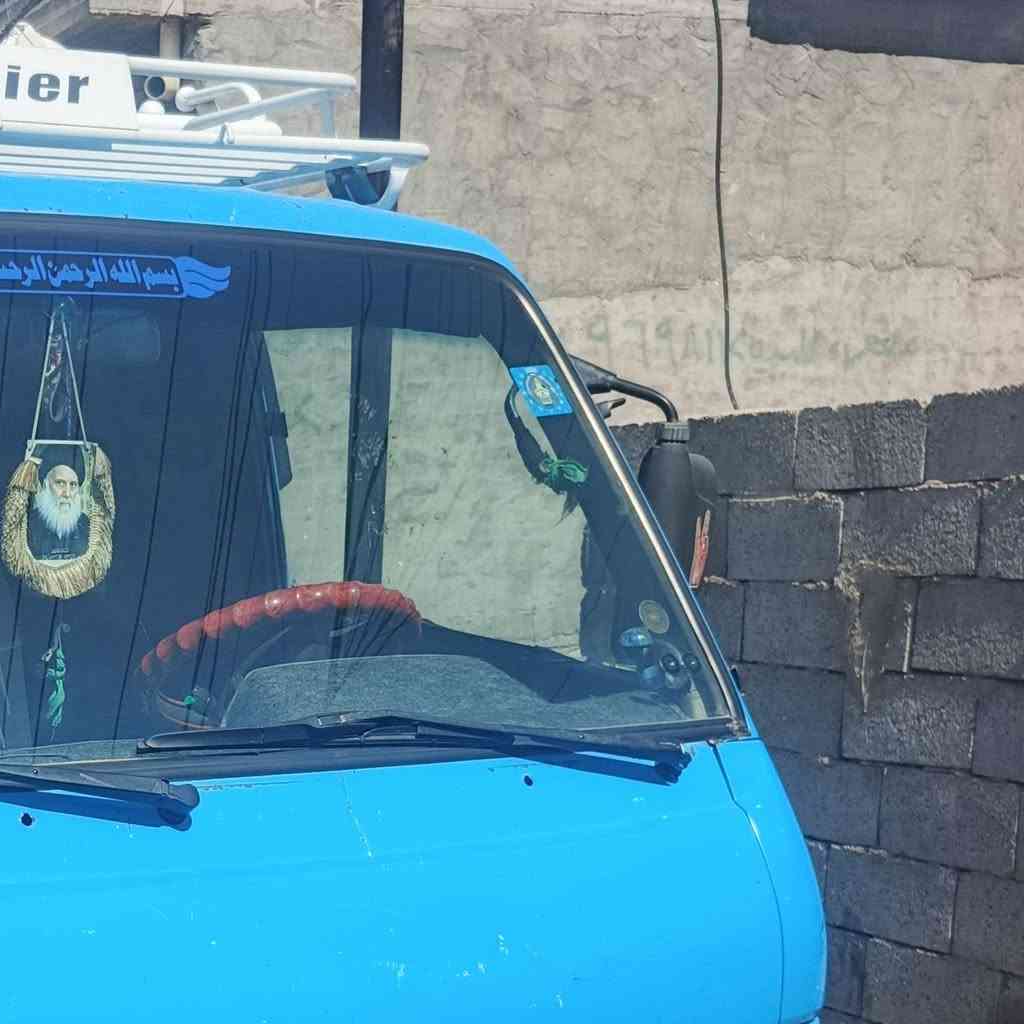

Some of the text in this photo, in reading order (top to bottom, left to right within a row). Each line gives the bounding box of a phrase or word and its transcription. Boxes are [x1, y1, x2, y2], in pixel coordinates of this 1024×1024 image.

[48, 257, 109, 288] الرحمن
[110, 258, 142, 284] الله
[143, 265, 179, 292] بسم
